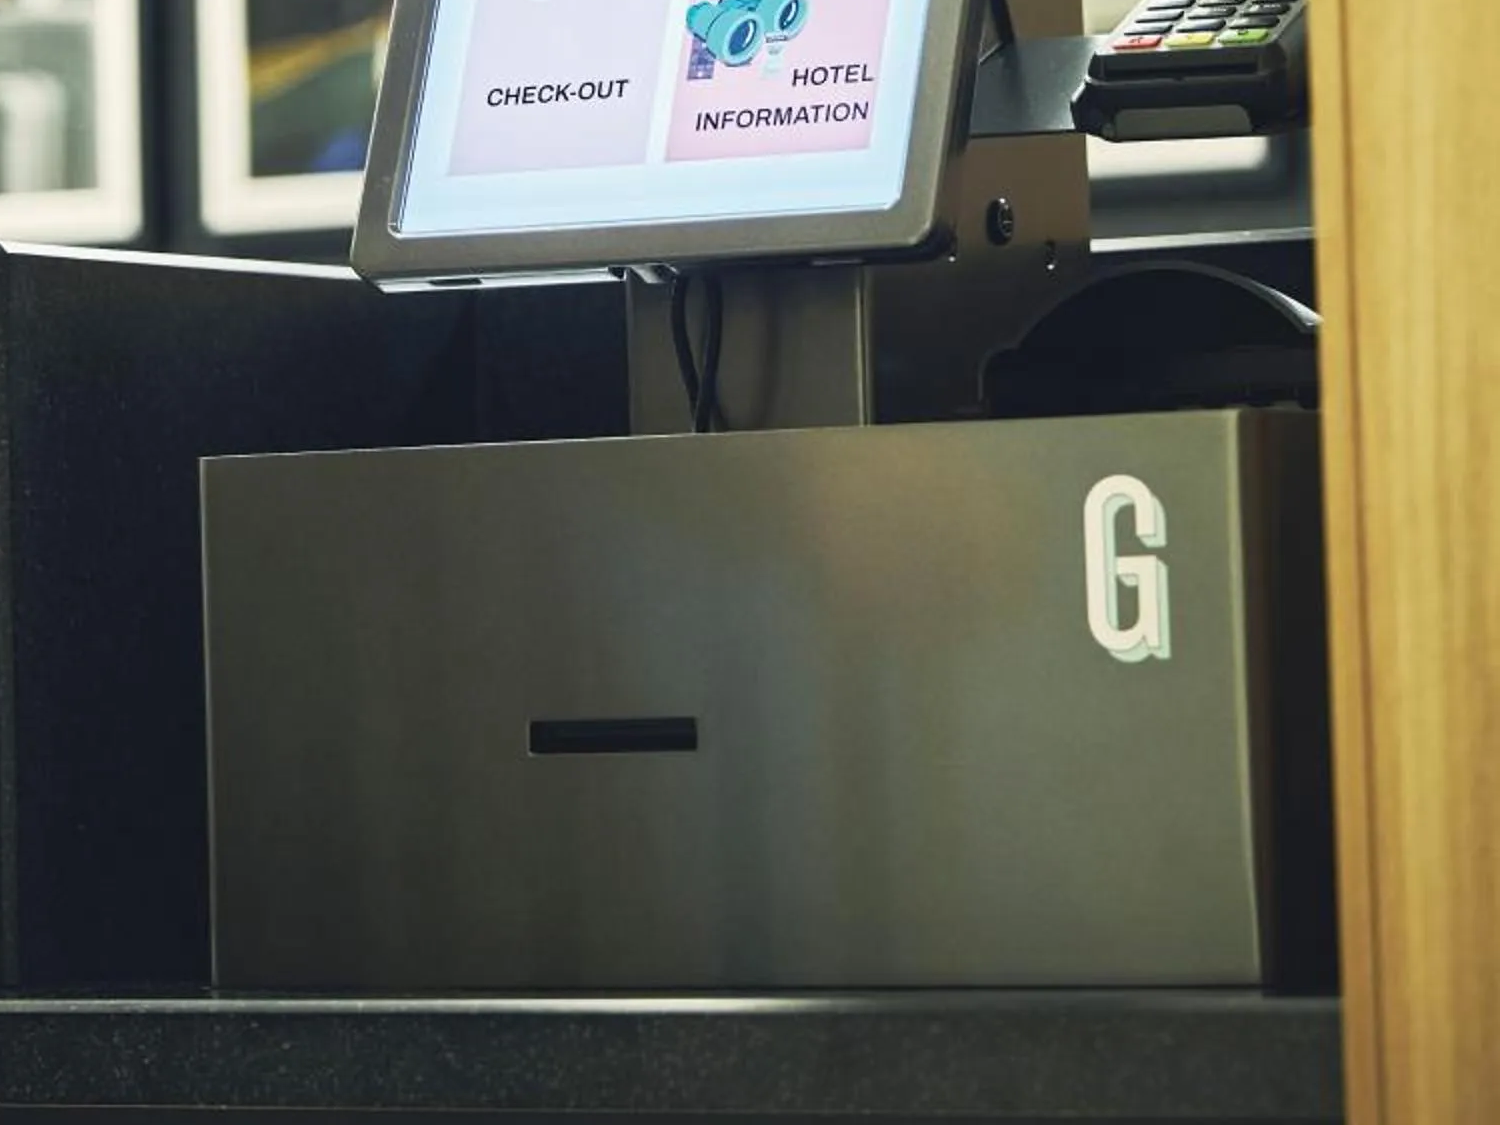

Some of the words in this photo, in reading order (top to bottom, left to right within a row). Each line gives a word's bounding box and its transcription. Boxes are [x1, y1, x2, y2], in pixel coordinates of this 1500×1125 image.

[791, 63, 875, 88] HOTEL
[486, 78, 630, 107] CHECK-OUT
[695, 101, 870, 132] INFORMATION
[1083, 474, 1171, 663] G
